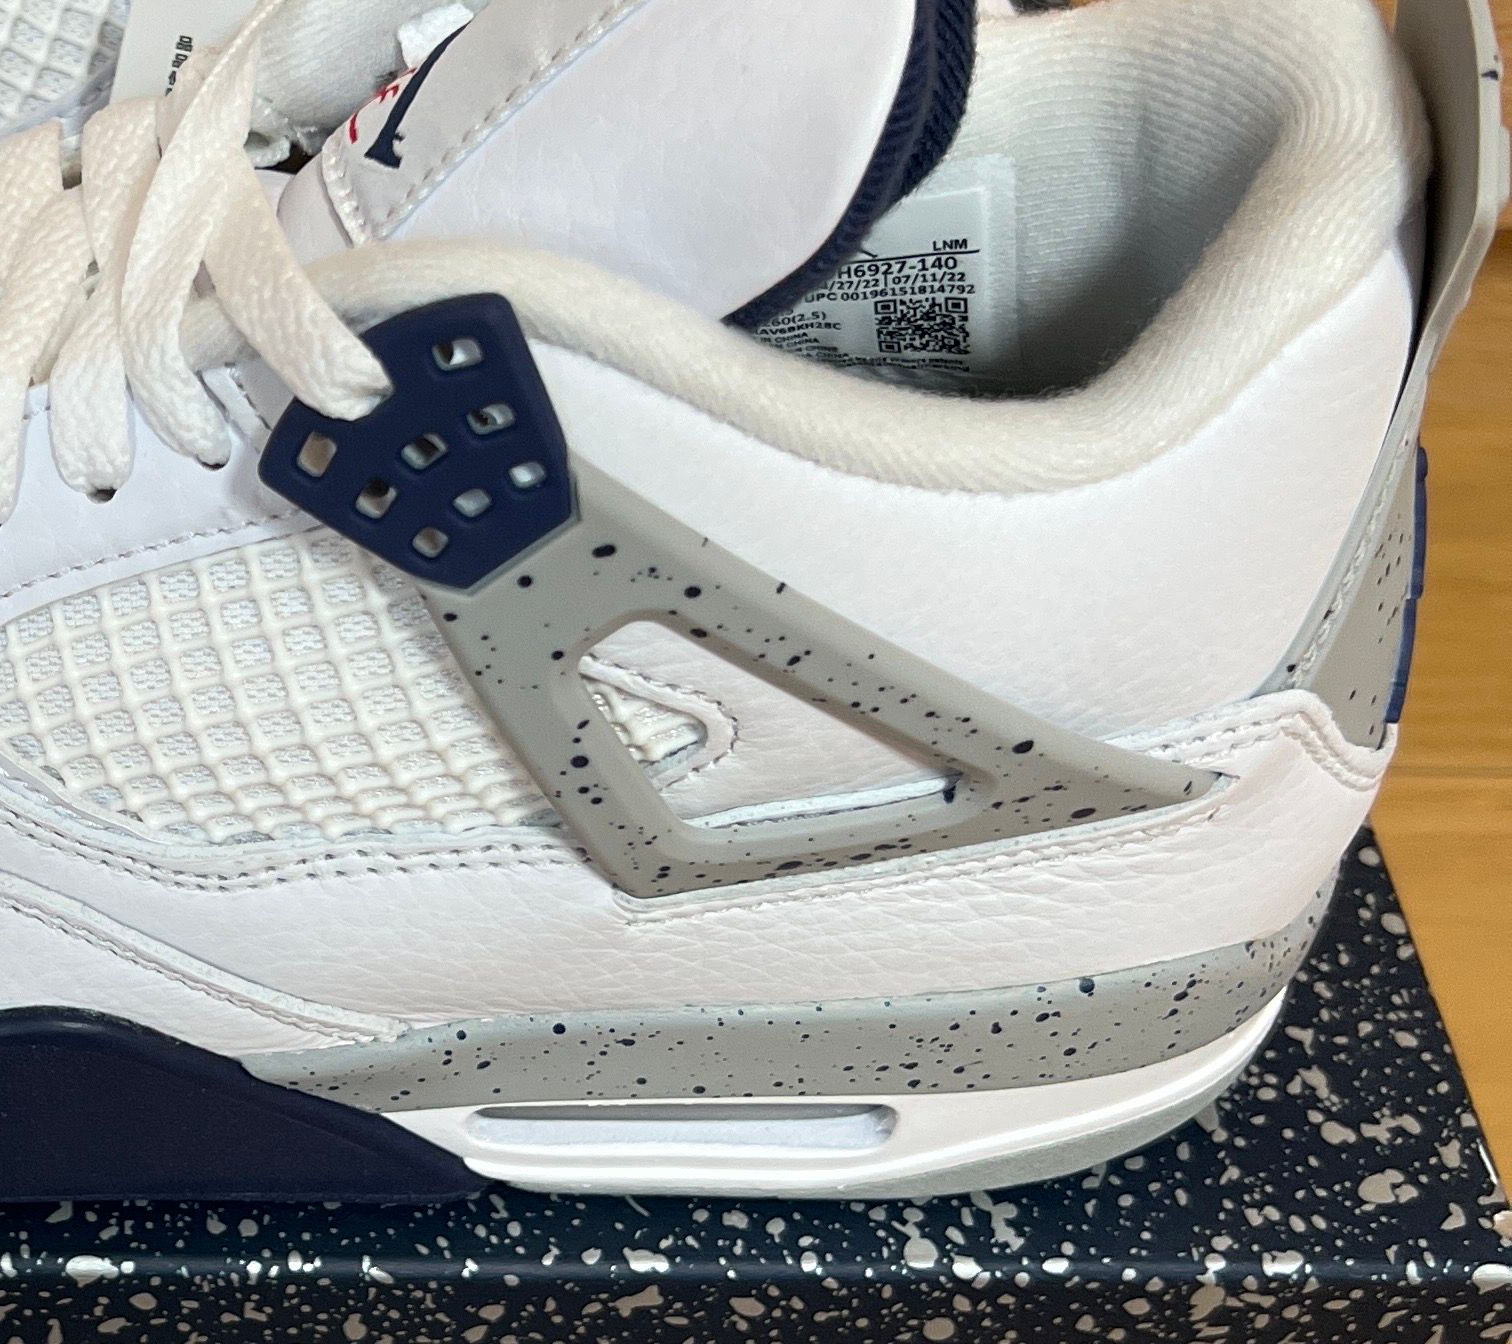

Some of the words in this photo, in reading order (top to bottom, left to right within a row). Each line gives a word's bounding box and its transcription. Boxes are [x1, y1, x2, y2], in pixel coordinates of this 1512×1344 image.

[932, 238, 968, 252] LNM
[822, 278, 880, 291] /27/22
[892, 272, 966, 286] 07/11/22
[804, 292, 838, 304] UPC
[840, 284, 976, 302] 00196151814792
